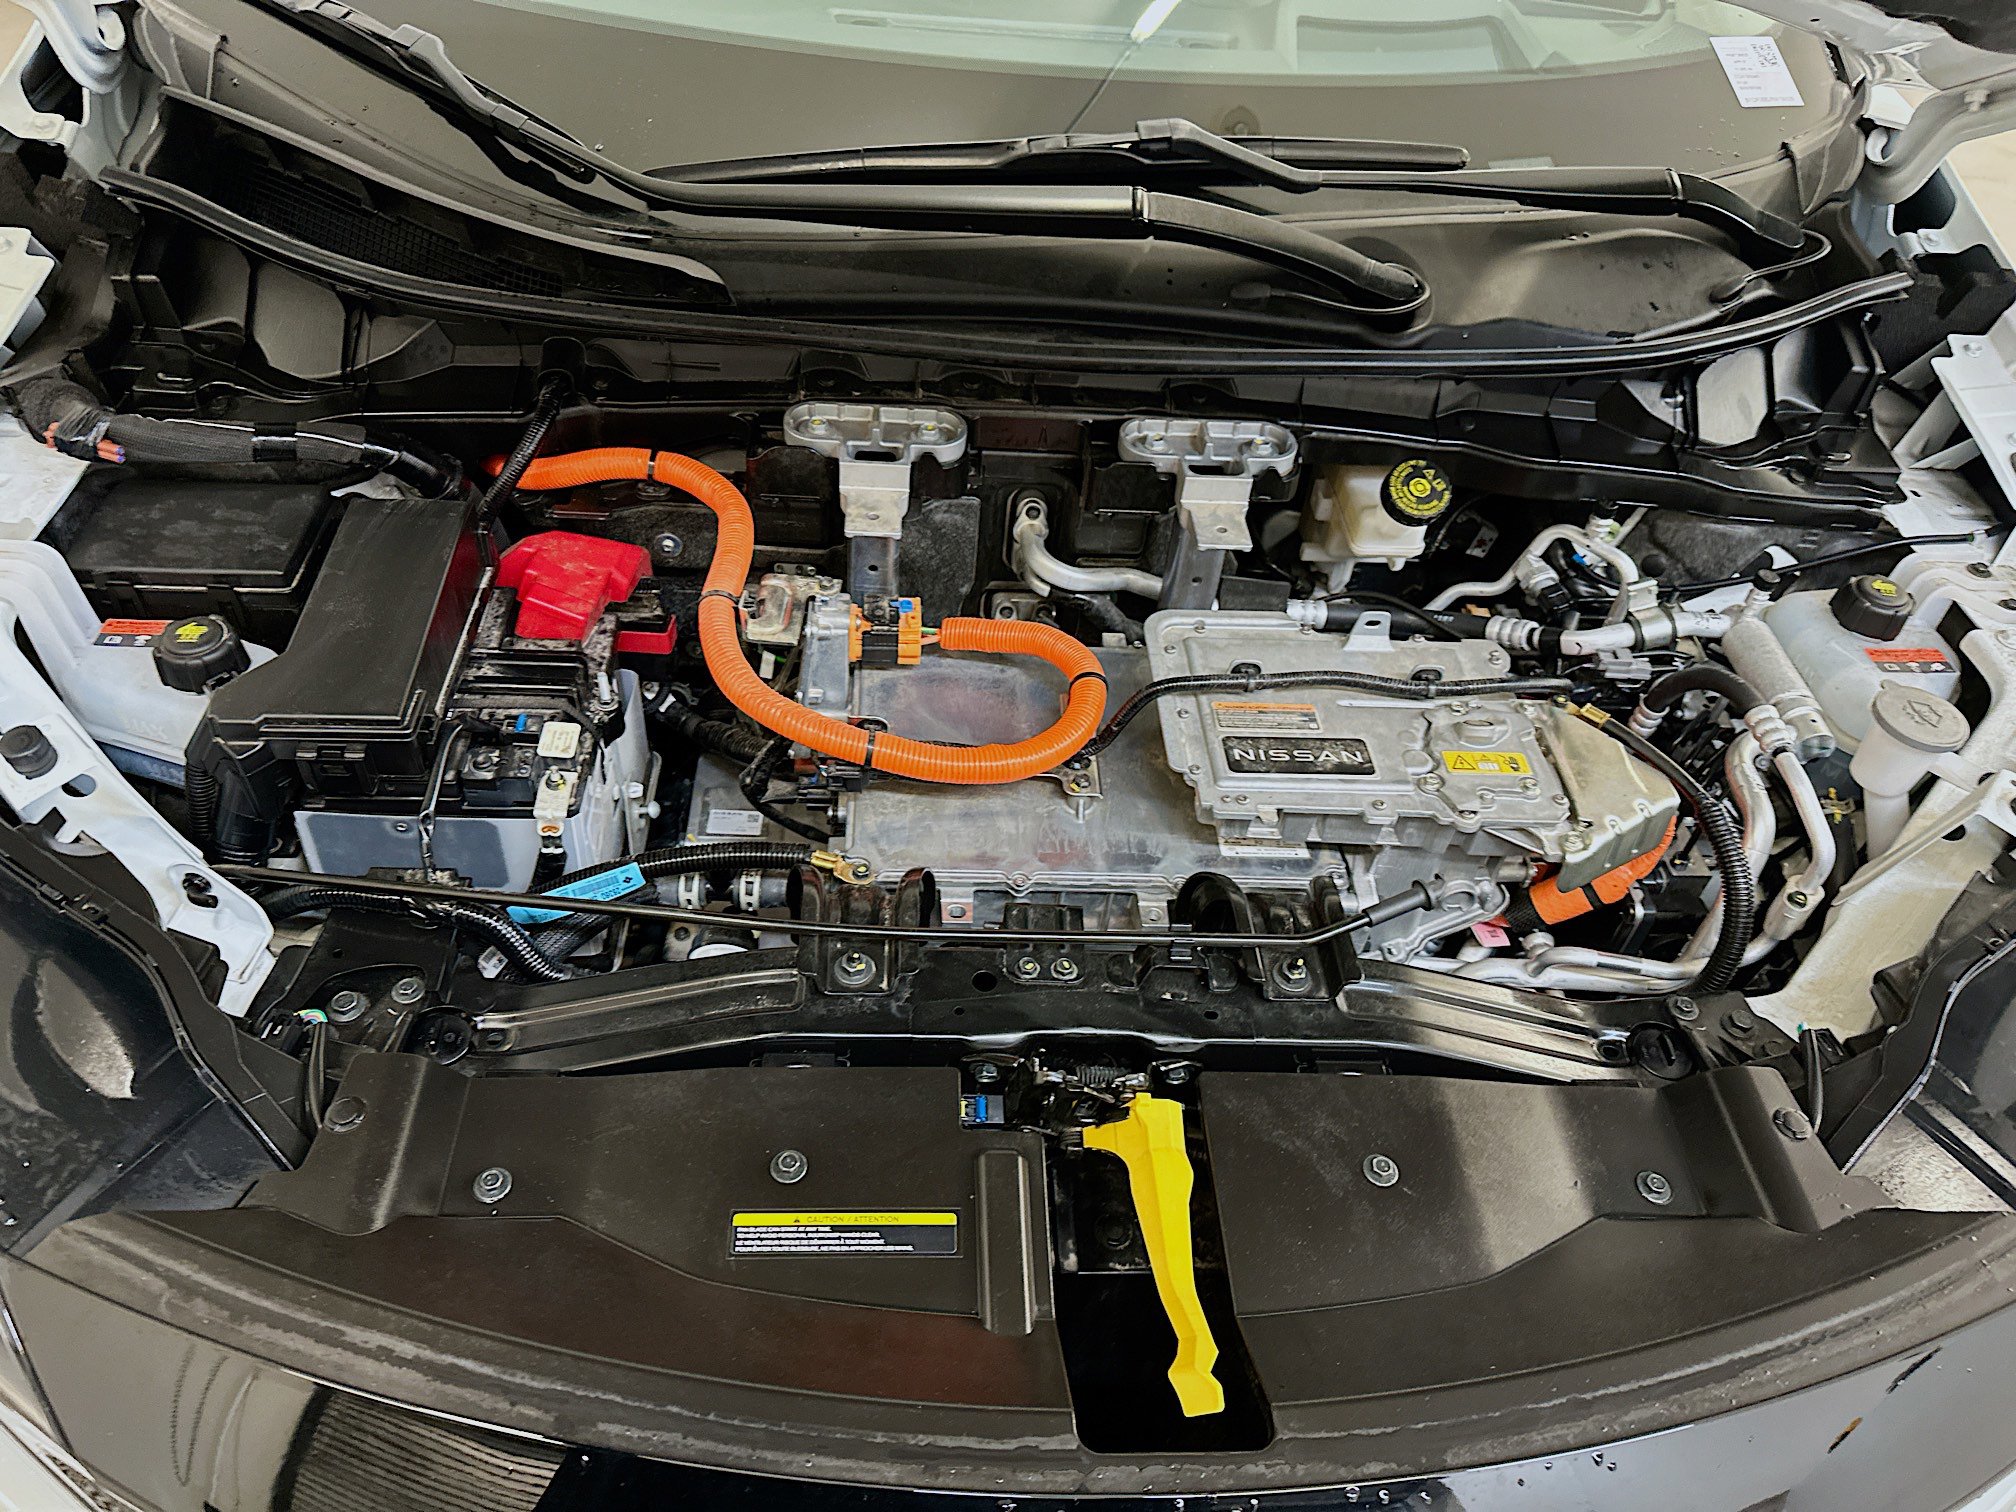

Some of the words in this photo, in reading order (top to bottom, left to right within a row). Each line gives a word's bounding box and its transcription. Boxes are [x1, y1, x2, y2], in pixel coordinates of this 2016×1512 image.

[1232, 748, 1365, 763] NISSAN
[806, 1215, 844, 1223] CAUTION
[854, 1215, 900, 1223] ATTENTION
